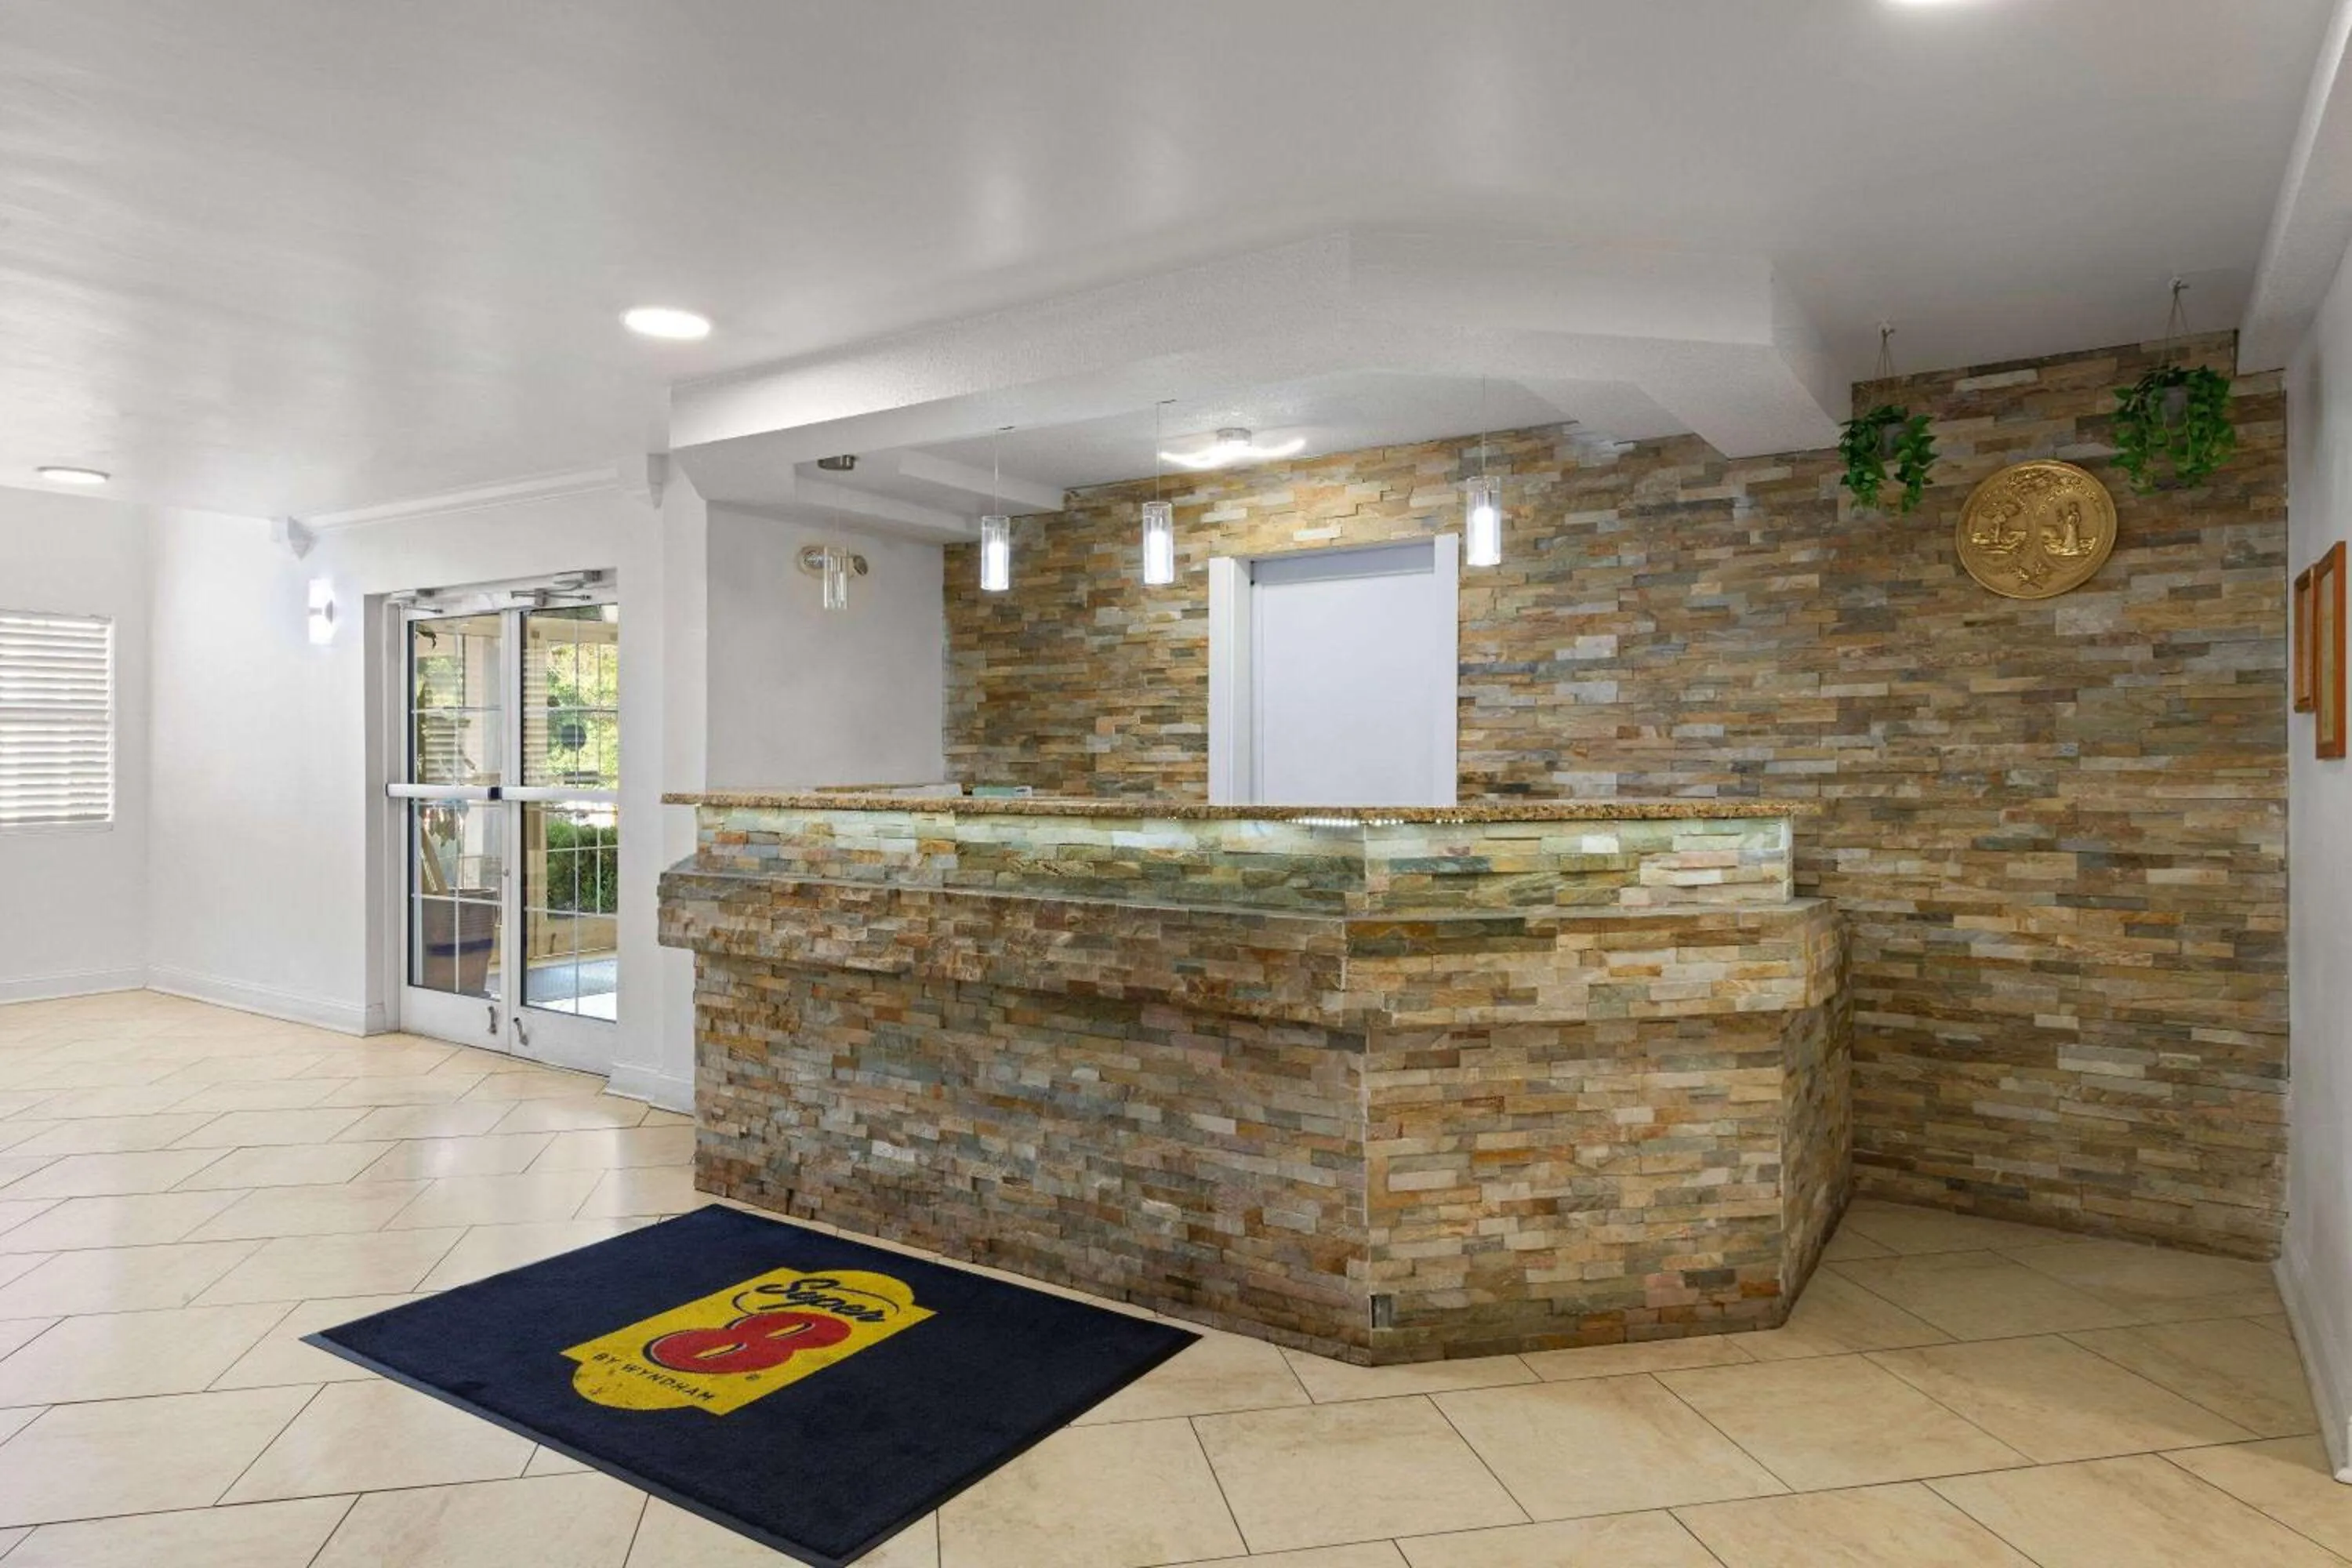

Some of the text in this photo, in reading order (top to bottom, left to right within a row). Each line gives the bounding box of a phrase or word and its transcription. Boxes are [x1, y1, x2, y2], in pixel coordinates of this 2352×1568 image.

[754, 1278, 886, 1322] Super
[643, 1312, 853, 1374] 8
[592, 1352, 716, 1401] BY WYNDHAM
